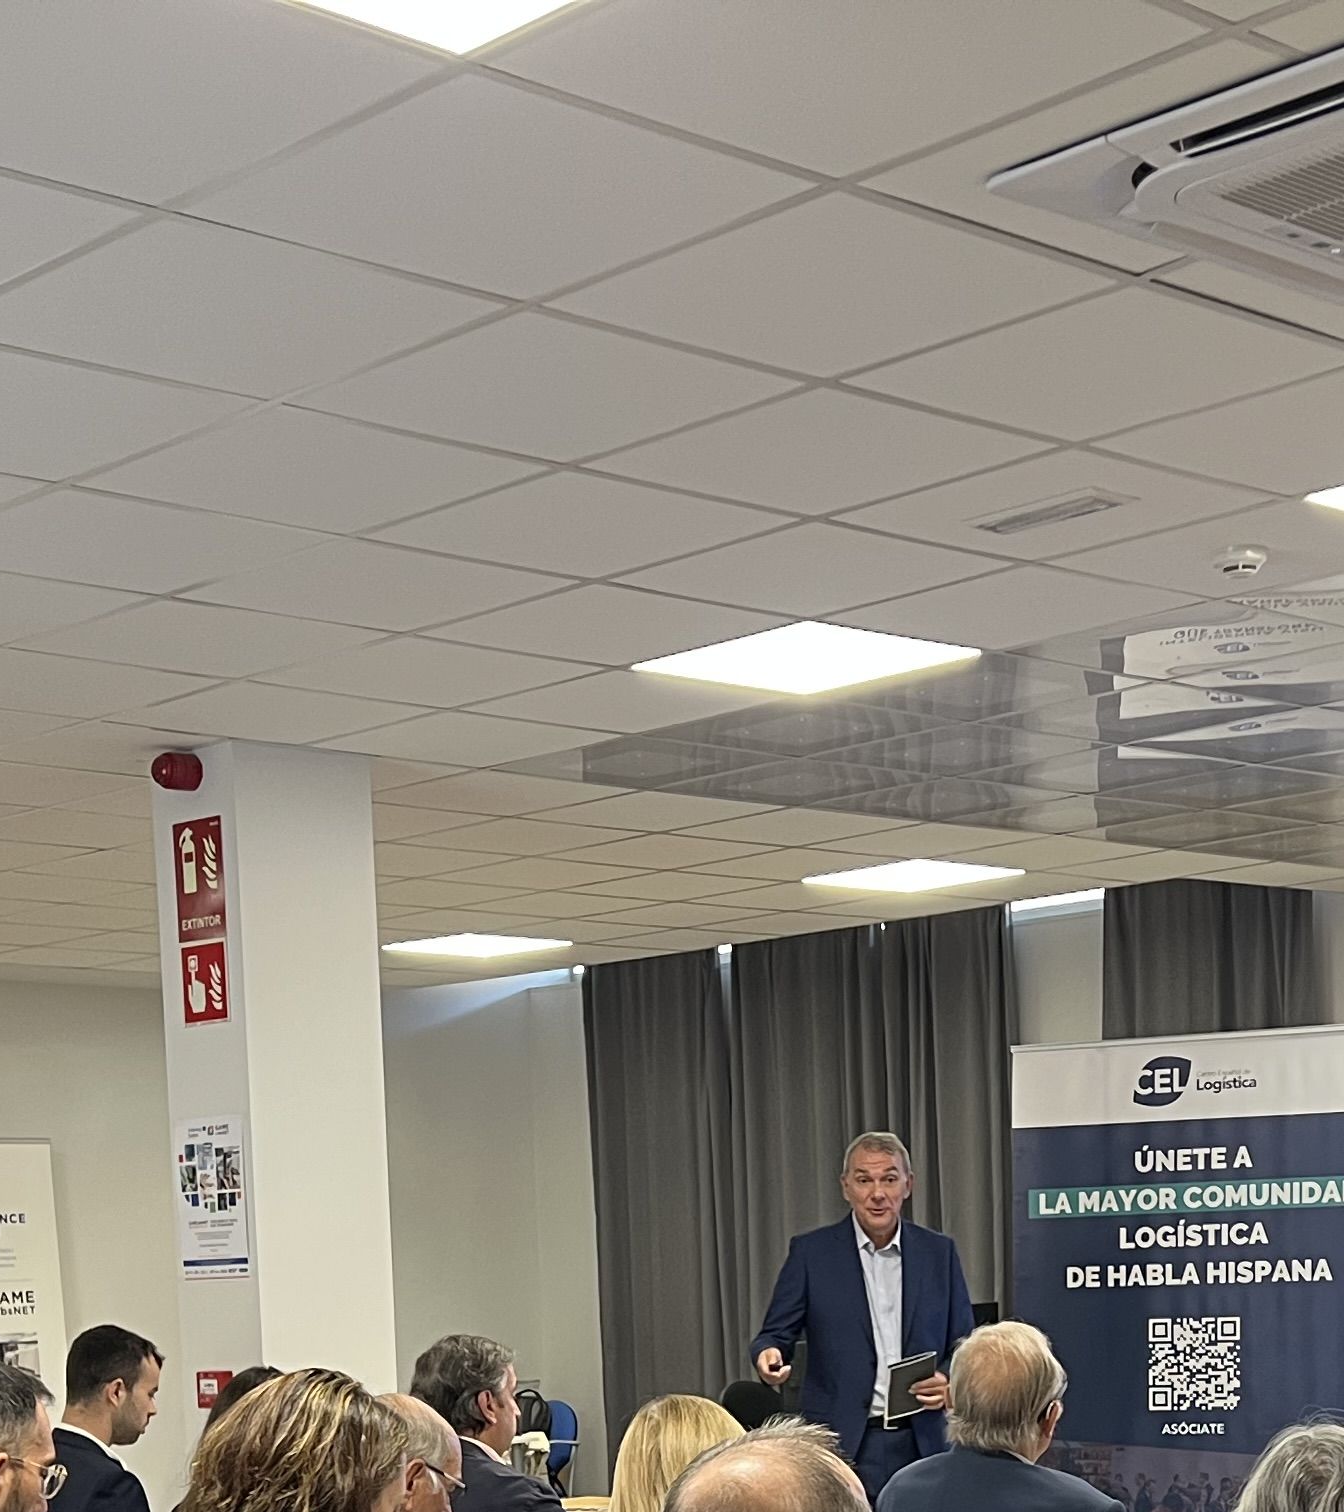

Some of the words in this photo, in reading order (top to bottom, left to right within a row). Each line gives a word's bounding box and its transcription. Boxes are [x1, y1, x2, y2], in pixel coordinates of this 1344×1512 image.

[182, 914, 222, 932] EXTINTOR
[1136, 1067, 1186, 1096] CEL
[1197, 1075, 1257, 1093] Logística
[1135, 1145, 1227, 1173] ÚNETE
[1233, 1146, 1253, 1168] A
[1039, 1192, 1072, 1215] LA
[1078, 1187, 1177, 1213] MAYOR
[1119, 1219, 1269, 1250] LOGÍSTICA
[1066, 1266, 1101, 1289] DE
[1107, 1262, 1200, 1287] HABLA
[1206, 1258, 1334, 1284] HISPANA
[1161, 1421, 1225, 1435] ASÓCIATE
